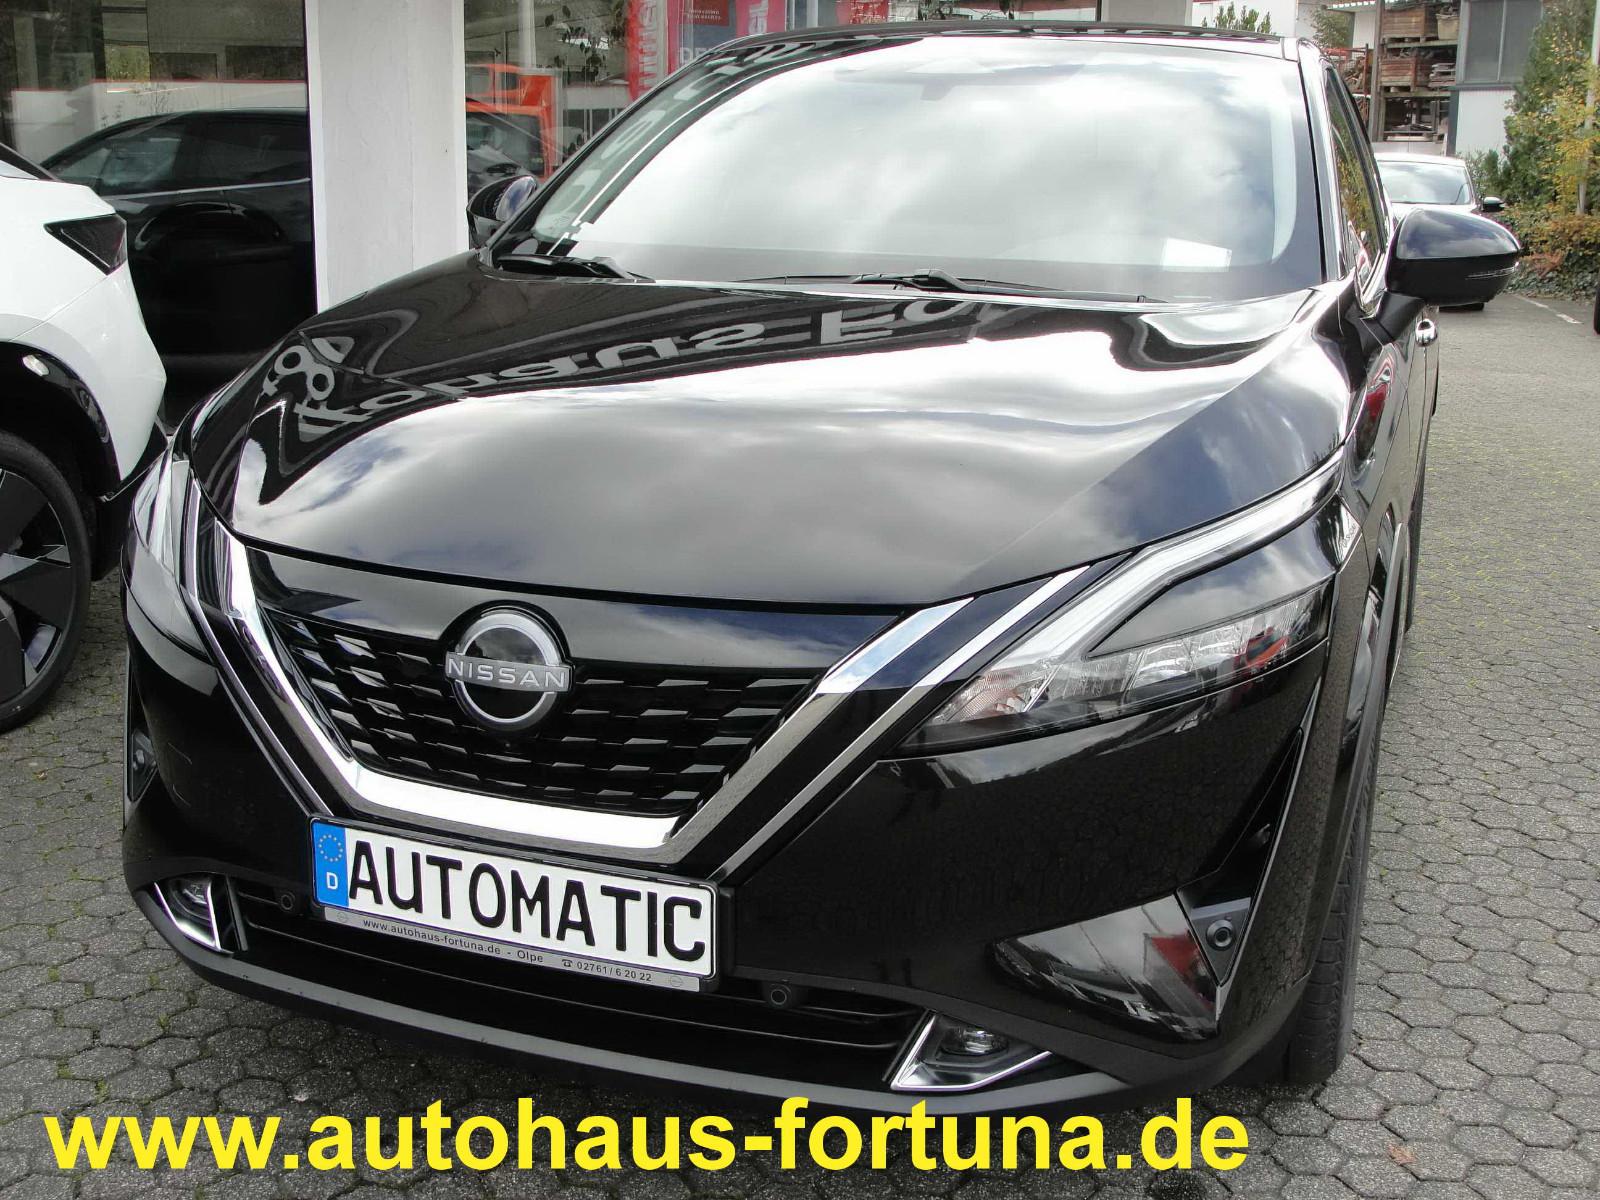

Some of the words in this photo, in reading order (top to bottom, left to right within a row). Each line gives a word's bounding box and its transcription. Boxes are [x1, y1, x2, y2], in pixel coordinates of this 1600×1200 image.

[447, 658, 566, 688] NISSAN
[326, 871, 339, 890] D
[349, 839, 706, 962] AUTOMATIC
[362, 918, 501, 955] www.autohaus-fortuna.de
[517, 950, 544, 963] Olpe
[625, 969, 637, 979] 20
[640, 972, 652, 982] 22
